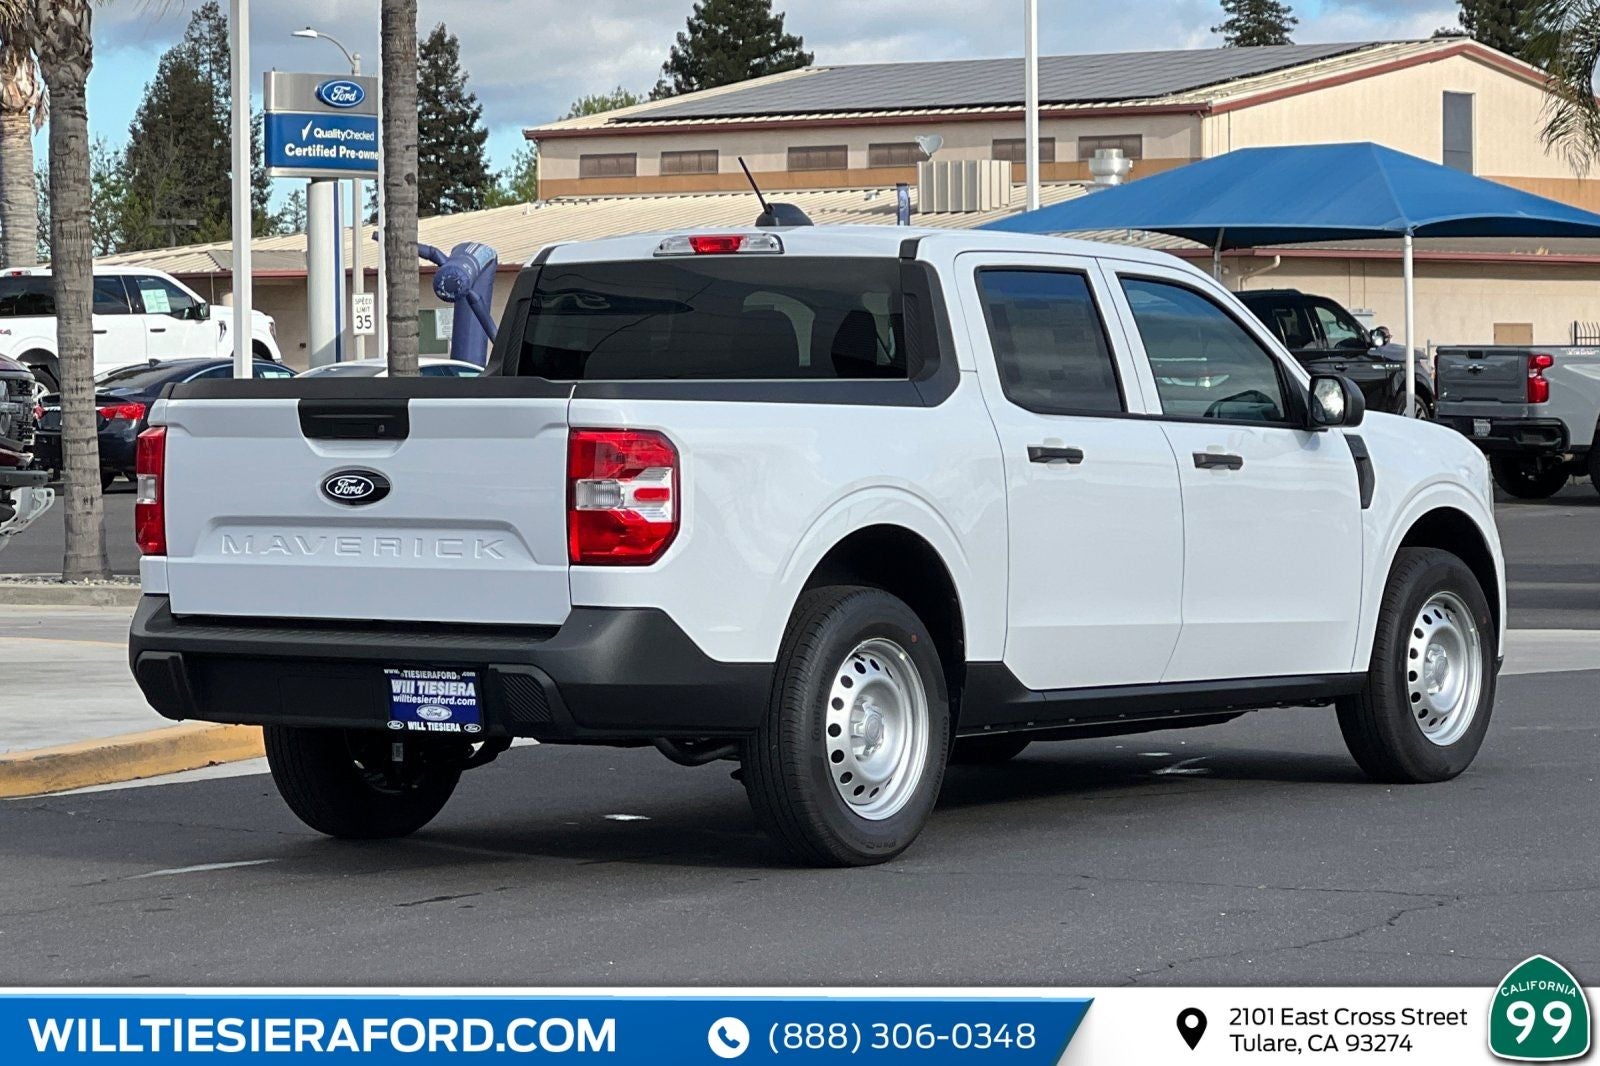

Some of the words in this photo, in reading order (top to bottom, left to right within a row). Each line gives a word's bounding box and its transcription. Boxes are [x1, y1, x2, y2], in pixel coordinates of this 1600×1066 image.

[331, 85, 357, 101] Ford
[313, 127, 375, 141] QualityChecked
[285, 143, 336, 158] Certified
[339, 145, 379, 160] Pre-owne
[355, 297, 373, 305] SPEED
[356, 306, 371, 314] LIMIT
[356, 315, 372, 329] 35
[334, 478, 364, 495] Ford
[221, 534, 505, 560] MAVERICK
[417, 680, 476, 697] TIESIERA
[392, 694, 476, 706] willtiesieraford.com
[407, 721, 426, 731] WILL
[427, 722, 461, 733] TIESIERA
